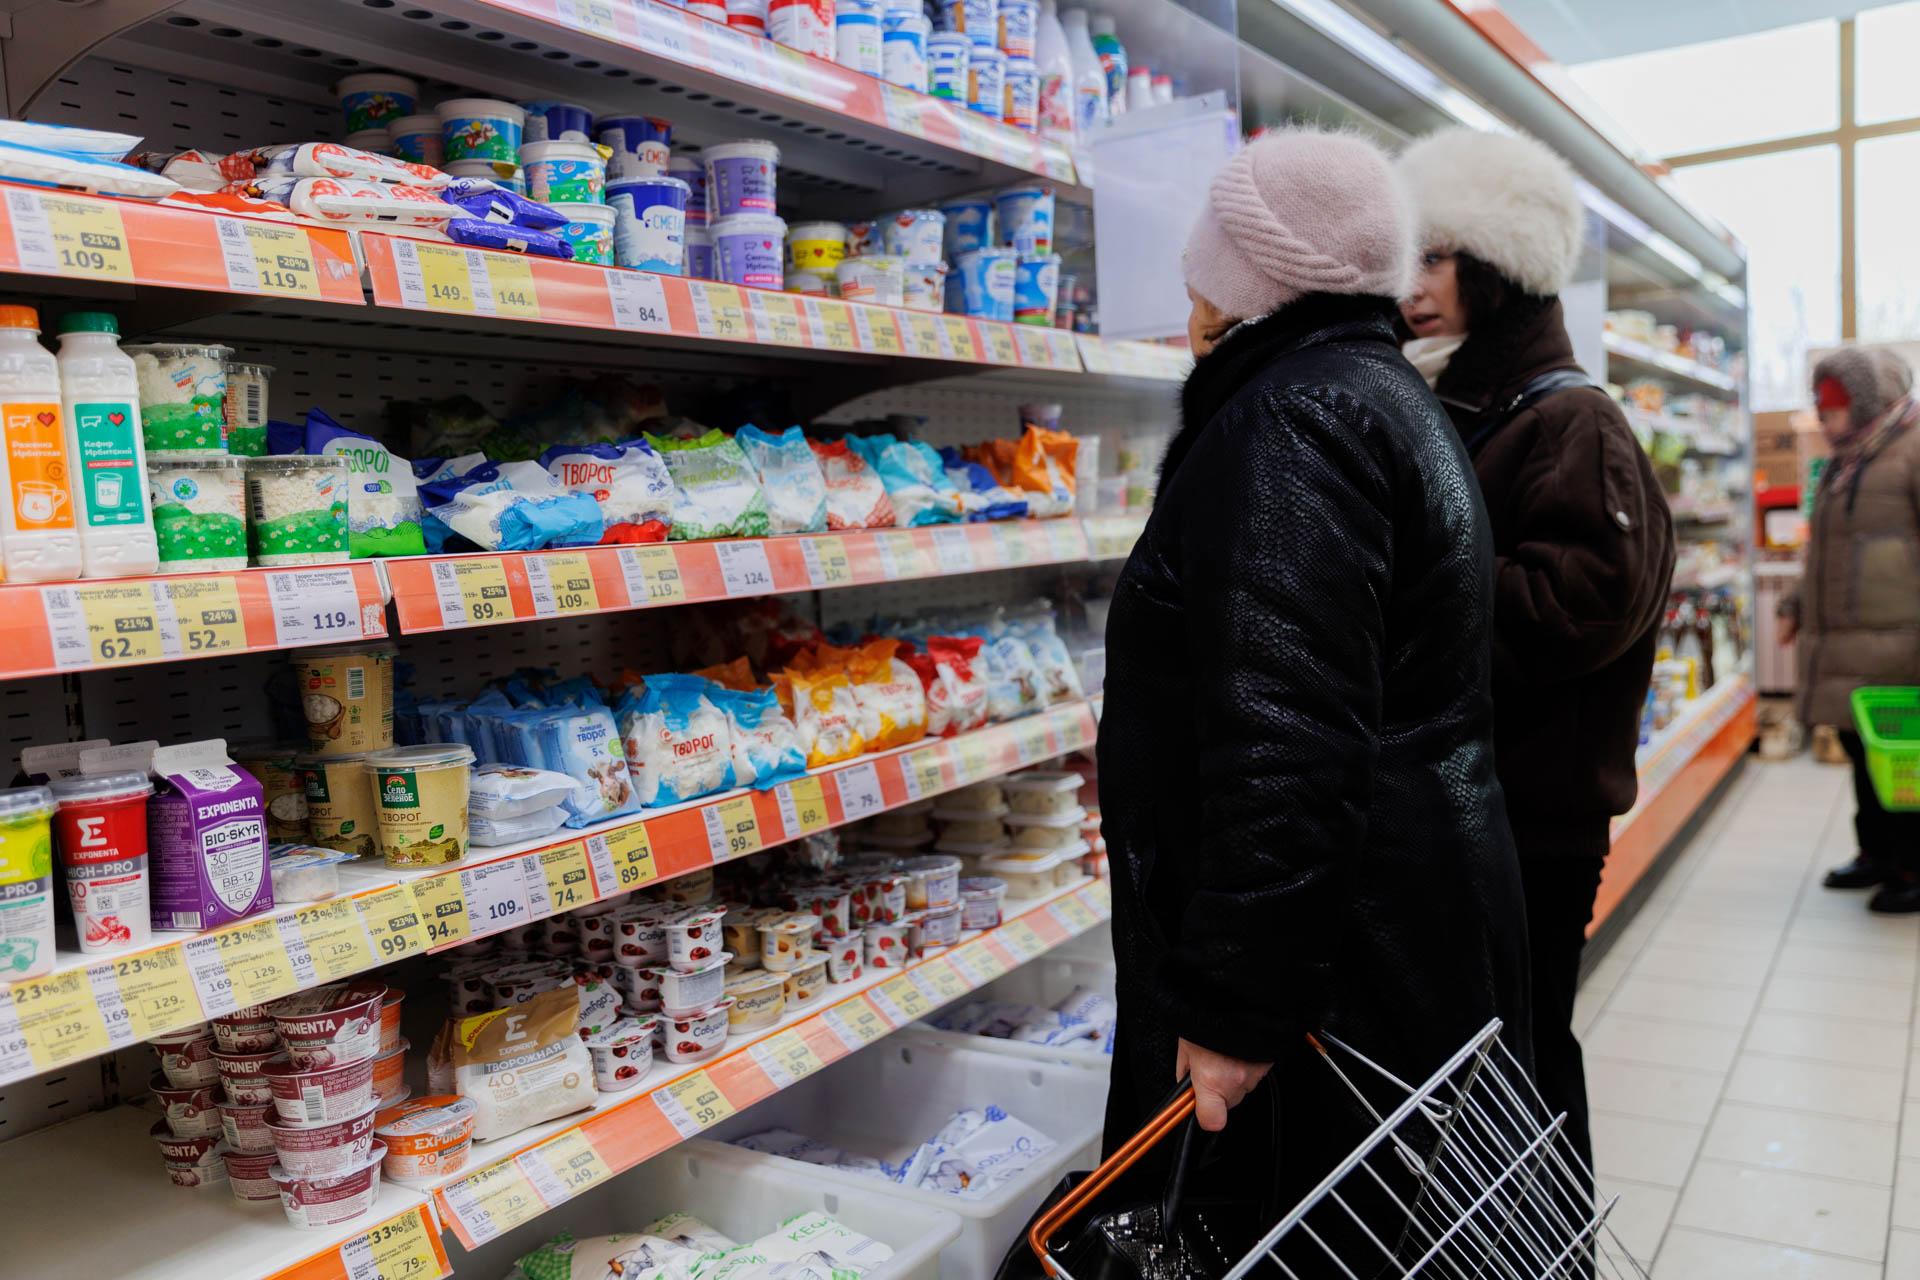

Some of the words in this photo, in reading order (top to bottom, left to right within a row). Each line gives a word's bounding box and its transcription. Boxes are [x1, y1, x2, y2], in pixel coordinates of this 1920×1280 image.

[84, 441, 113, 449] Кефир
[85, 448, 132, 458] Ирбитский
[562, 463, 617, 486] ТВОРОГ
[118, 617, 149, 629] -21%
[204, 611, 233, 622] -24%
[577, 728, 607, 743] творог
[672, 734, 715, 756] ТВОРОГ
[387, 785, 406, 794] Село
[198, 796, 258, 819] EXPONENTA
[383, 812, 421, 821] ТВОРОГ
[205, 824, 260, 846] BIO-SKYR
[731, 835, 746, 852] 99
[72, 848, 119, 859] EXPONENTA
[210, 852, 228, 866] 30
[68, 860, 134, 877] HIGH-PRO
[223, 871, 254, 888] BB-12
[228, 888, 252, 903] LGG
[276, 914, 298, 925] ИДКА
[299, 909, 332, 926] 23%
[391, 915, 415, 928] -23%
[186, 936, 218, 950] СКИДКА
[219, 931, 256, 949] 23%
[86, 964, 116, 977] КИДКА
[117, 958, 158, 977] 23%
[253, 966, 276, 980] 129
[209, 978, 232, 992] 169
[15, 984, 59, 1004] 23%
[154, 995, 178, 1010] 129
[104, 1008, 130, 1024] 169
[56, 1022, 82, 1038] 129
[486, 1043, 562, 1073] ТВОРОЖНАЯ
[697, 1106, 716, 1124] 59
[352, 1136, 366, 1154] 20
[418, 1152, 437, 1167] 20
[564, 1167, 593, 1189] 149
[344, 1234, 371, 1250] СКИДКА
[372, 1223, 404, 1245] 33%
